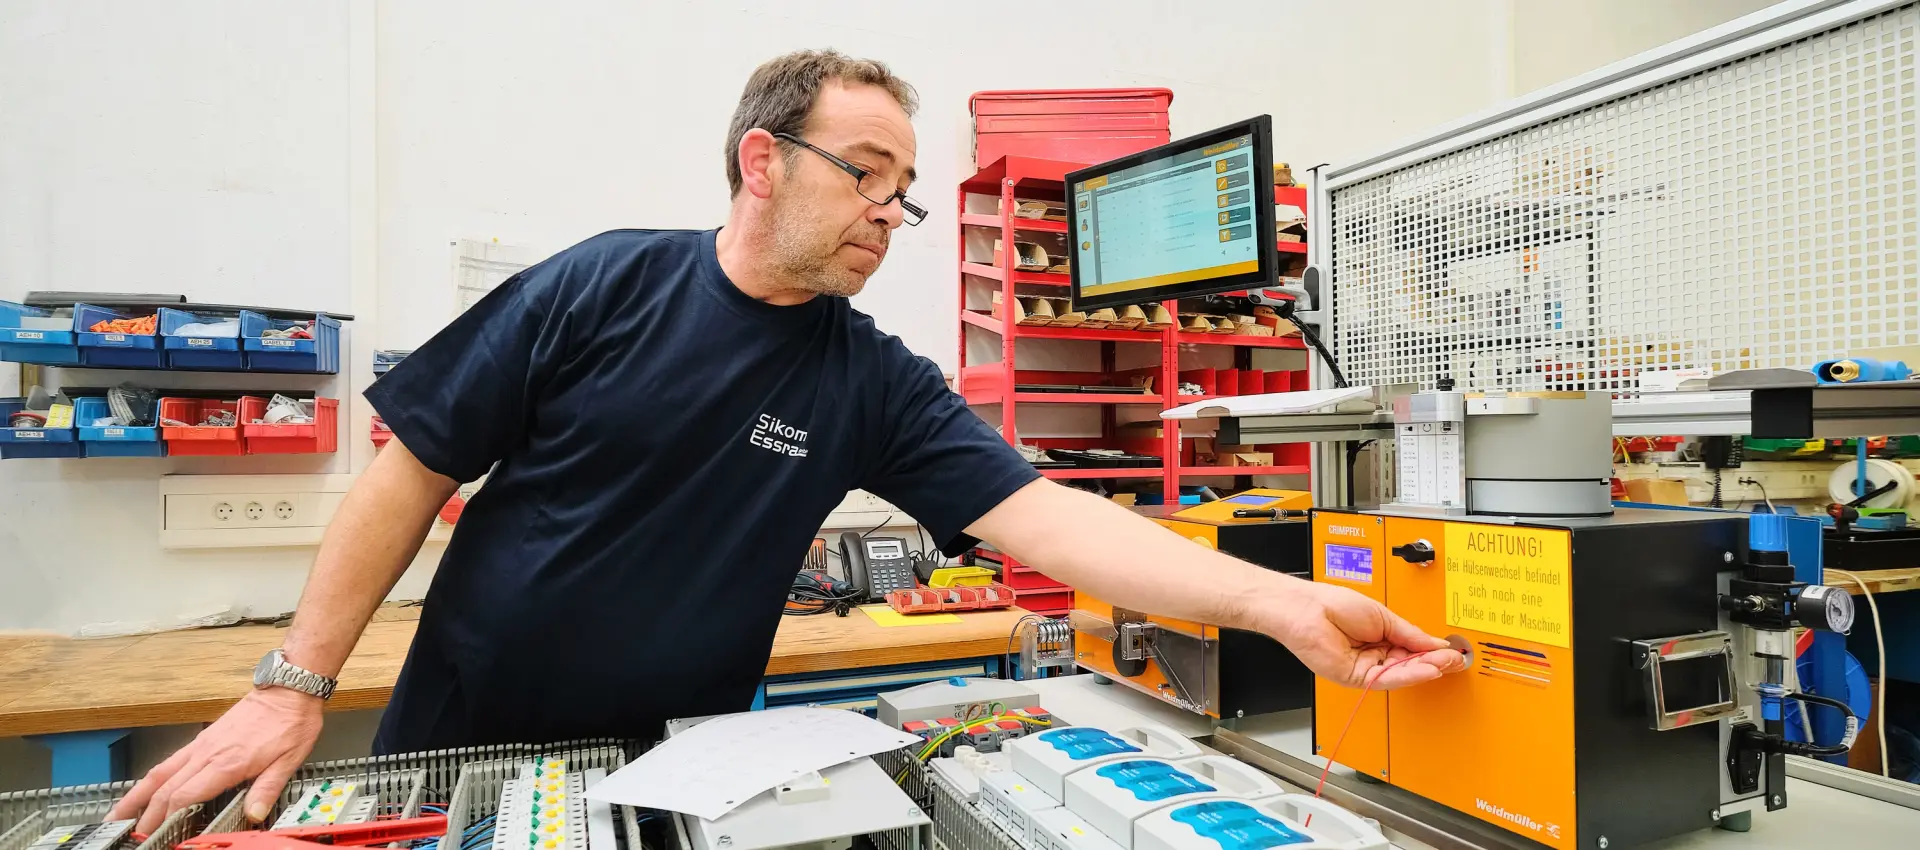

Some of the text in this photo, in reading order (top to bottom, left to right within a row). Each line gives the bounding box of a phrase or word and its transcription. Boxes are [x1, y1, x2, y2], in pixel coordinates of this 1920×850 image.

[755, 413, 808, 442] Sikom
[749, 428, 803, 457] Essra
[1328, 525, 1367, 538] CRIMPFIX L
[1467, 531, 1543, 558] ACHTUNG!
[1446, 556, 1459, 572] Bei
[1468, 582, 1543, 608] sich noch eine
[1488, 607, 1496, 623] in
[1501, 609, 1515, 626] der
[1519, 612, 1561, 635] Maschine
[1475, 797, 1544, 832] Weidmüller
